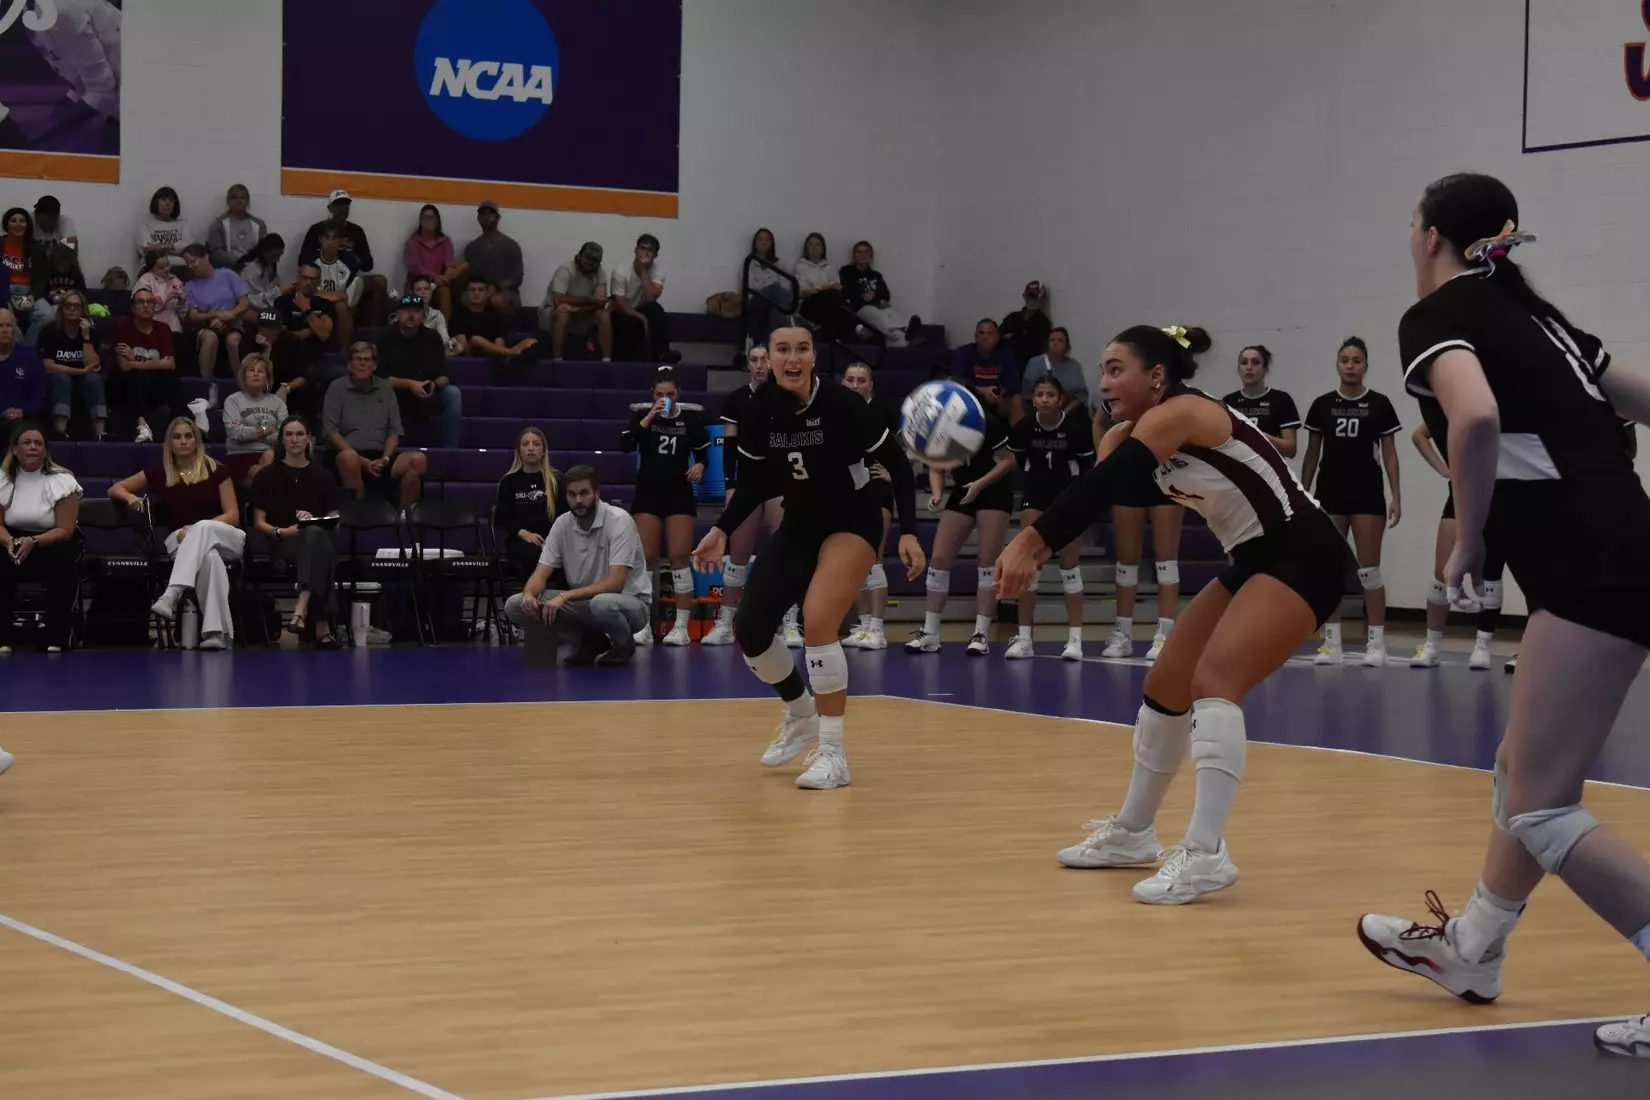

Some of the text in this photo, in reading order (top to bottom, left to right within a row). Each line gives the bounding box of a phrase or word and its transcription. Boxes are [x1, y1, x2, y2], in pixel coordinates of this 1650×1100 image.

[429, 56, 553, 105] NCAA
[260, 312, 276, 320] SIU
[1335, 418, 1360, 438] 20
[658, 435, 677, 455] 21
[768, 429, 824, 448] SALUKIS
[788, 452, 809, 480] 3
[1045, 450, 1052, 470] 1
